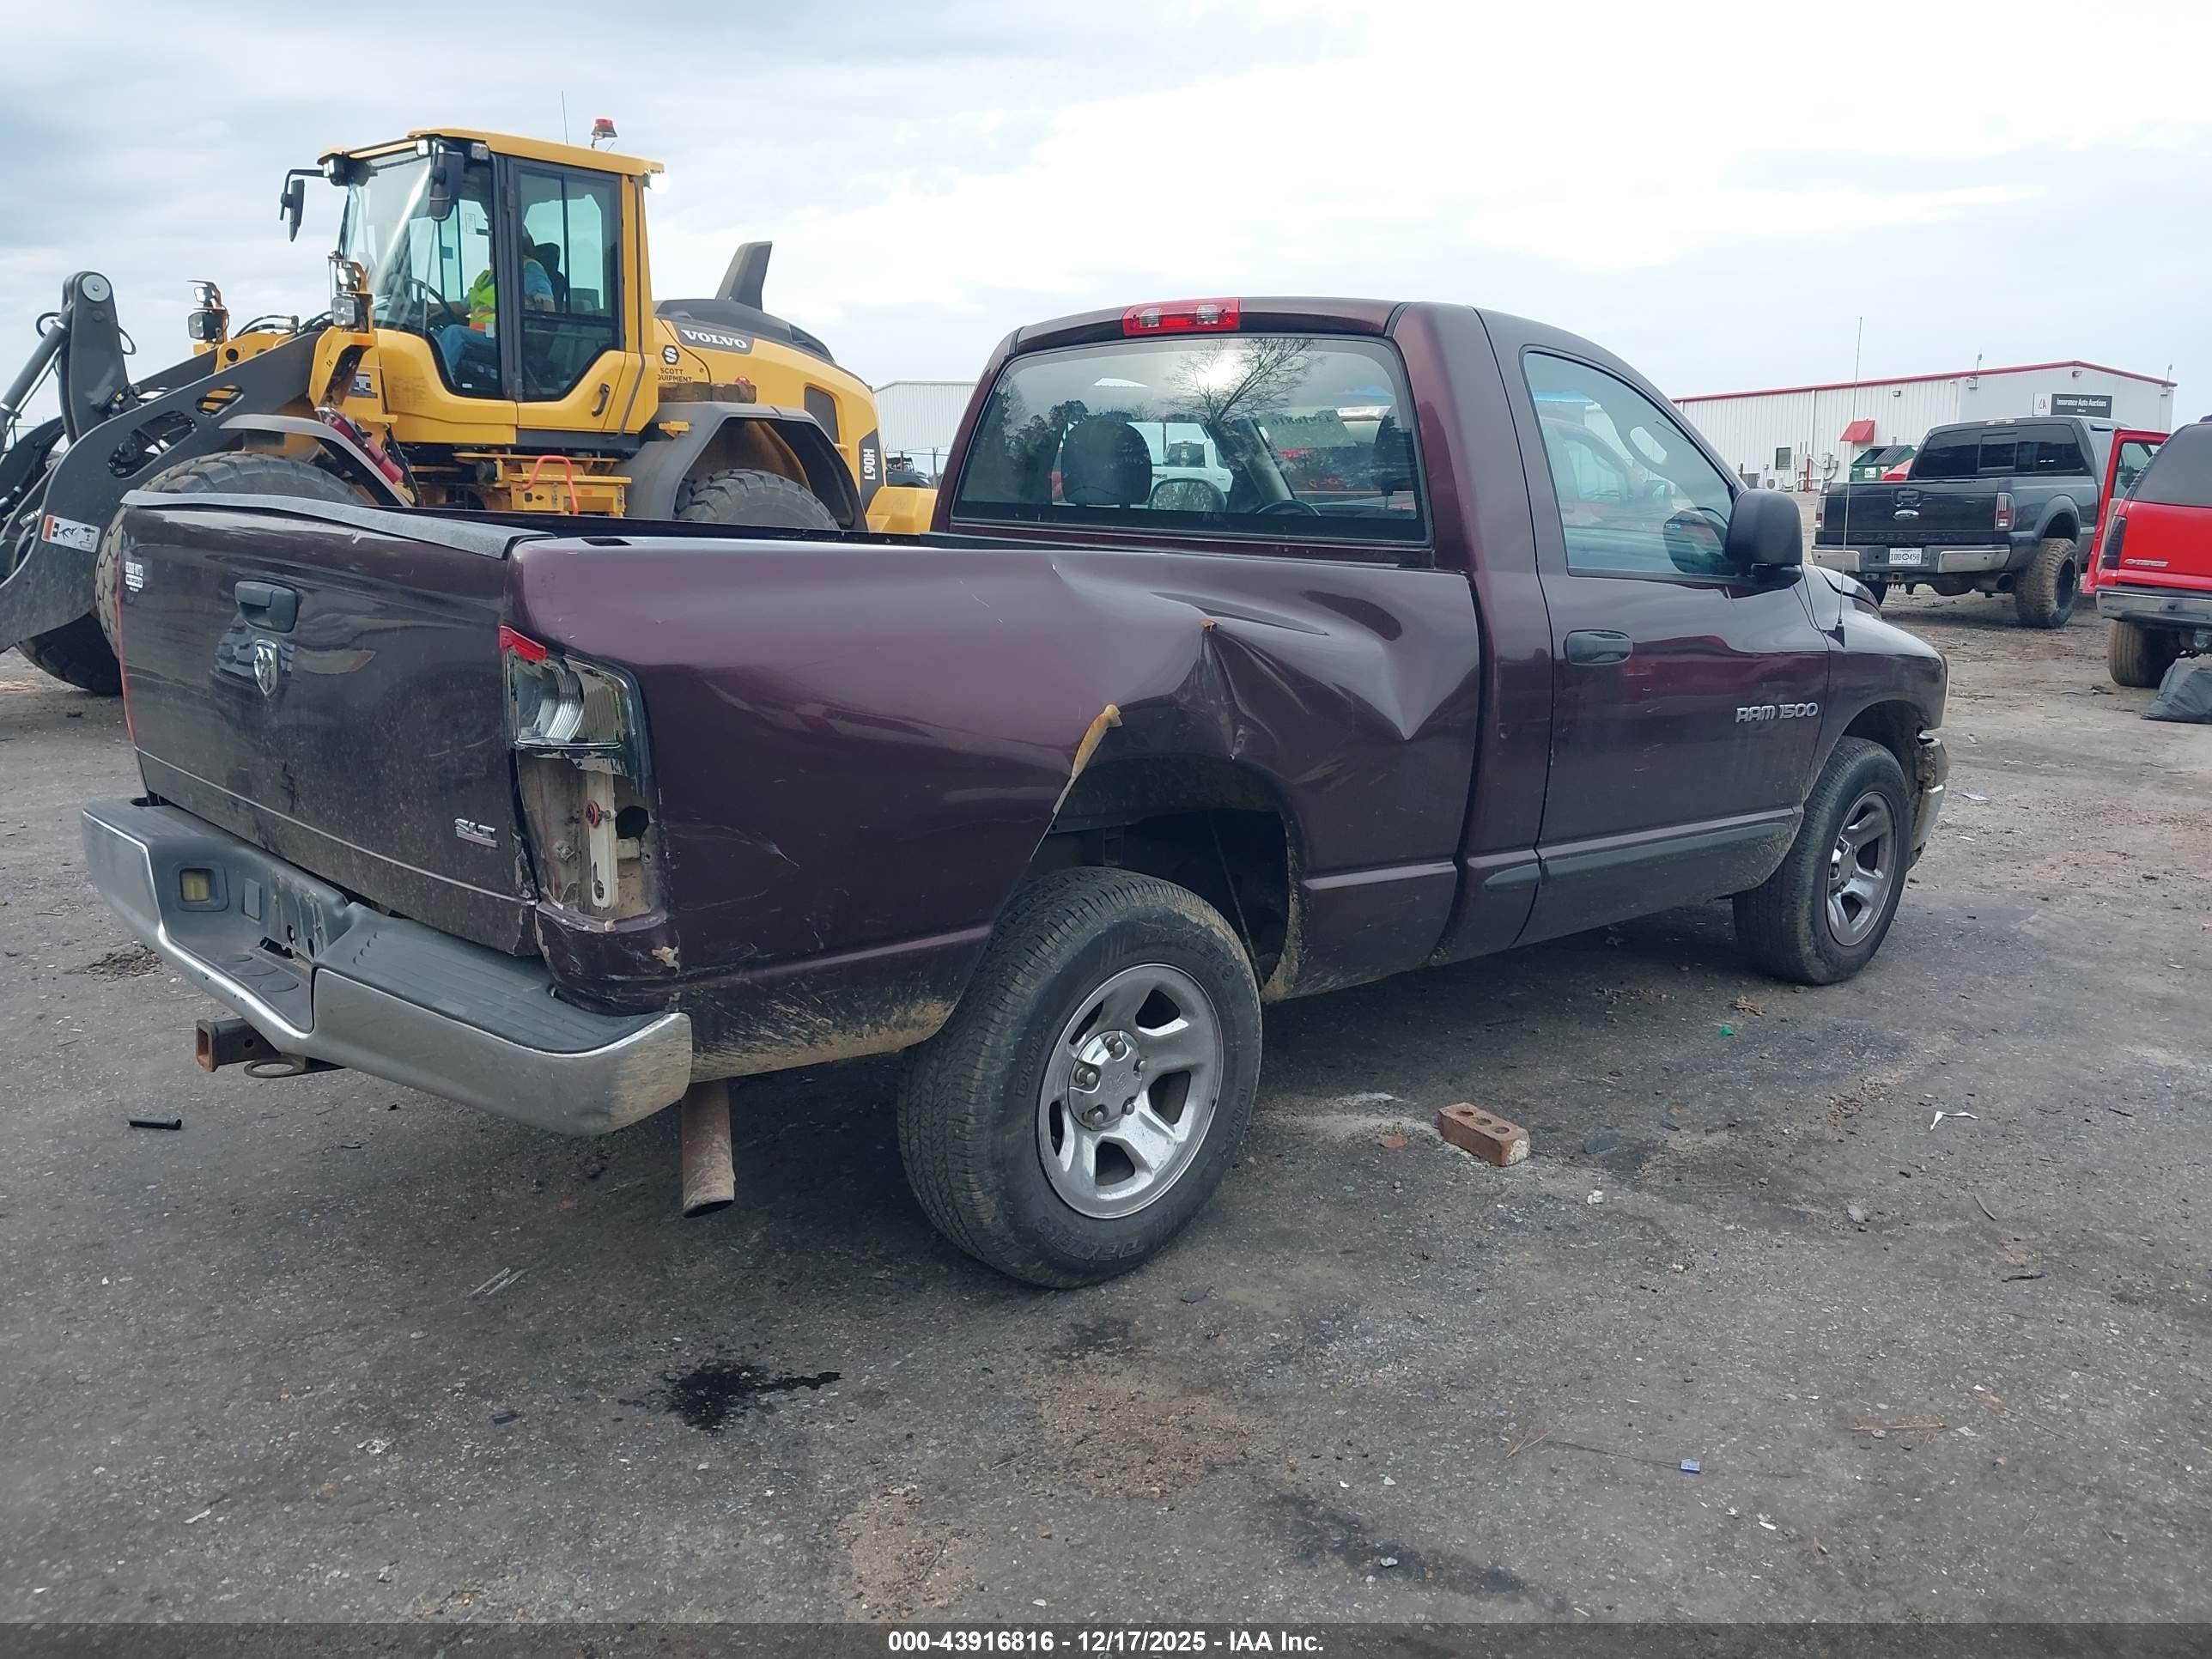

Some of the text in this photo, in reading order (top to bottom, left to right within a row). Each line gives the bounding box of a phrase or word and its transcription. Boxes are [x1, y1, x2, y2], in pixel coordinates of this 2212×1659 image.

[680, 329, 747, 349] VOLVO
[657, 374, 692, 383] QUIPMENT
[2078, 398, 2088, 407] Auto
[862, 448, 876, 480] L90H
[1735, 702, 1819, 722] RAM 1500
[454, 818, 496, 841] SLT
